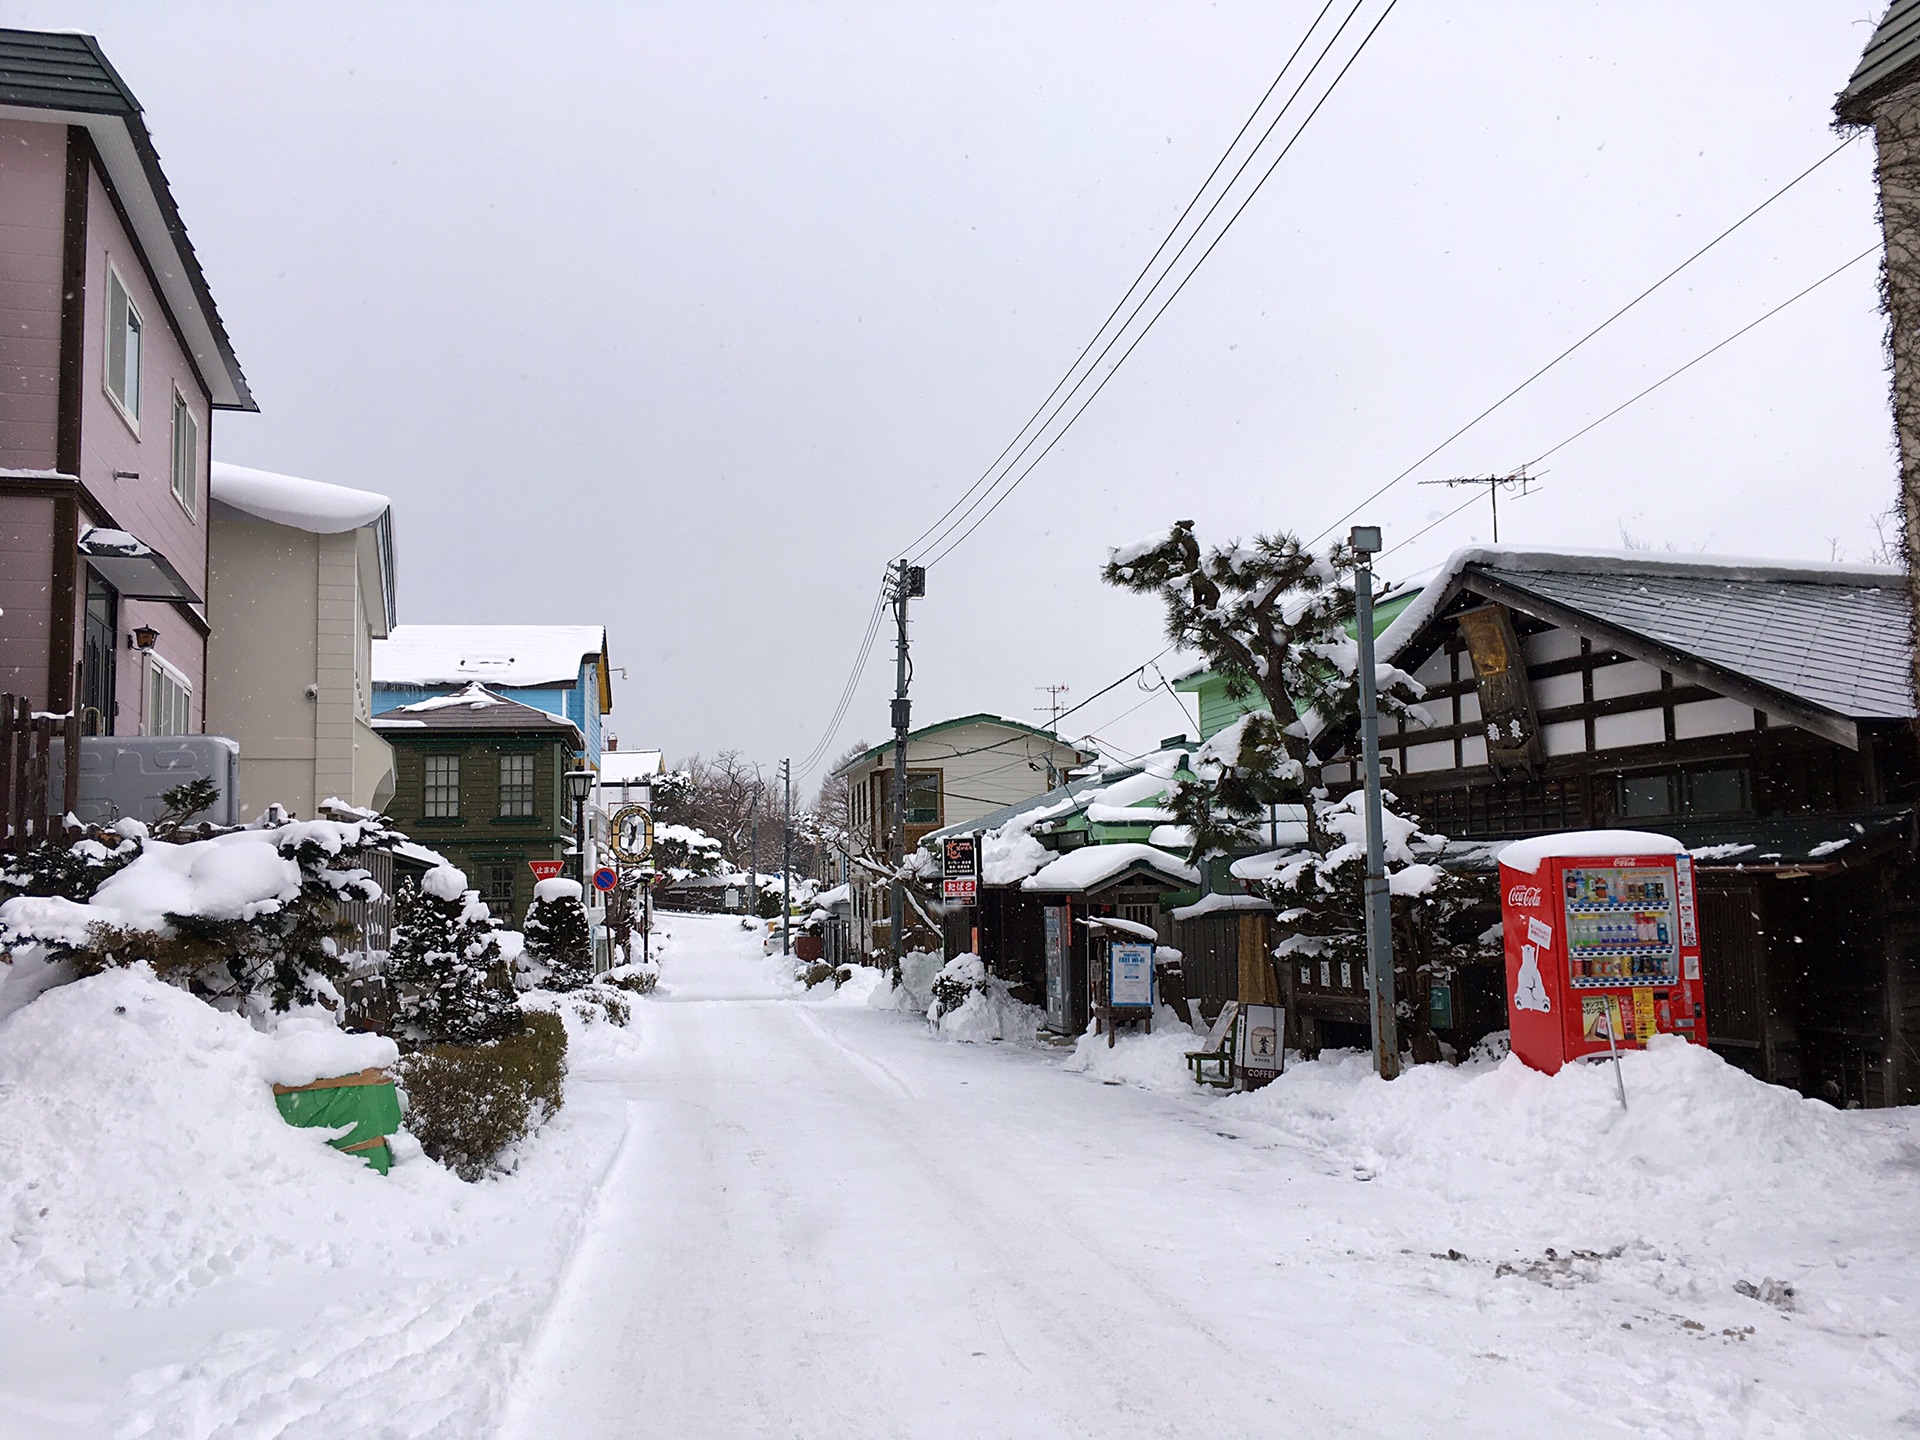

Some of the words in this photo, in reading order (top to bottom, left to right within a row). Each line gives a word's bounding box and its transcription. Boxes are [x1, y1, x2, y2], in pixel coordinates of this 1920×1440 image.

[1613, 857, 1637, 867] Coca-Cola
[536, 866, 557, 874] 止まれ
[947, 882, 973, 891] たばこ
[1508, 887, 1542, 907] Coca-Cola
[1247, 1069, 1277, 1079] COFFEE
